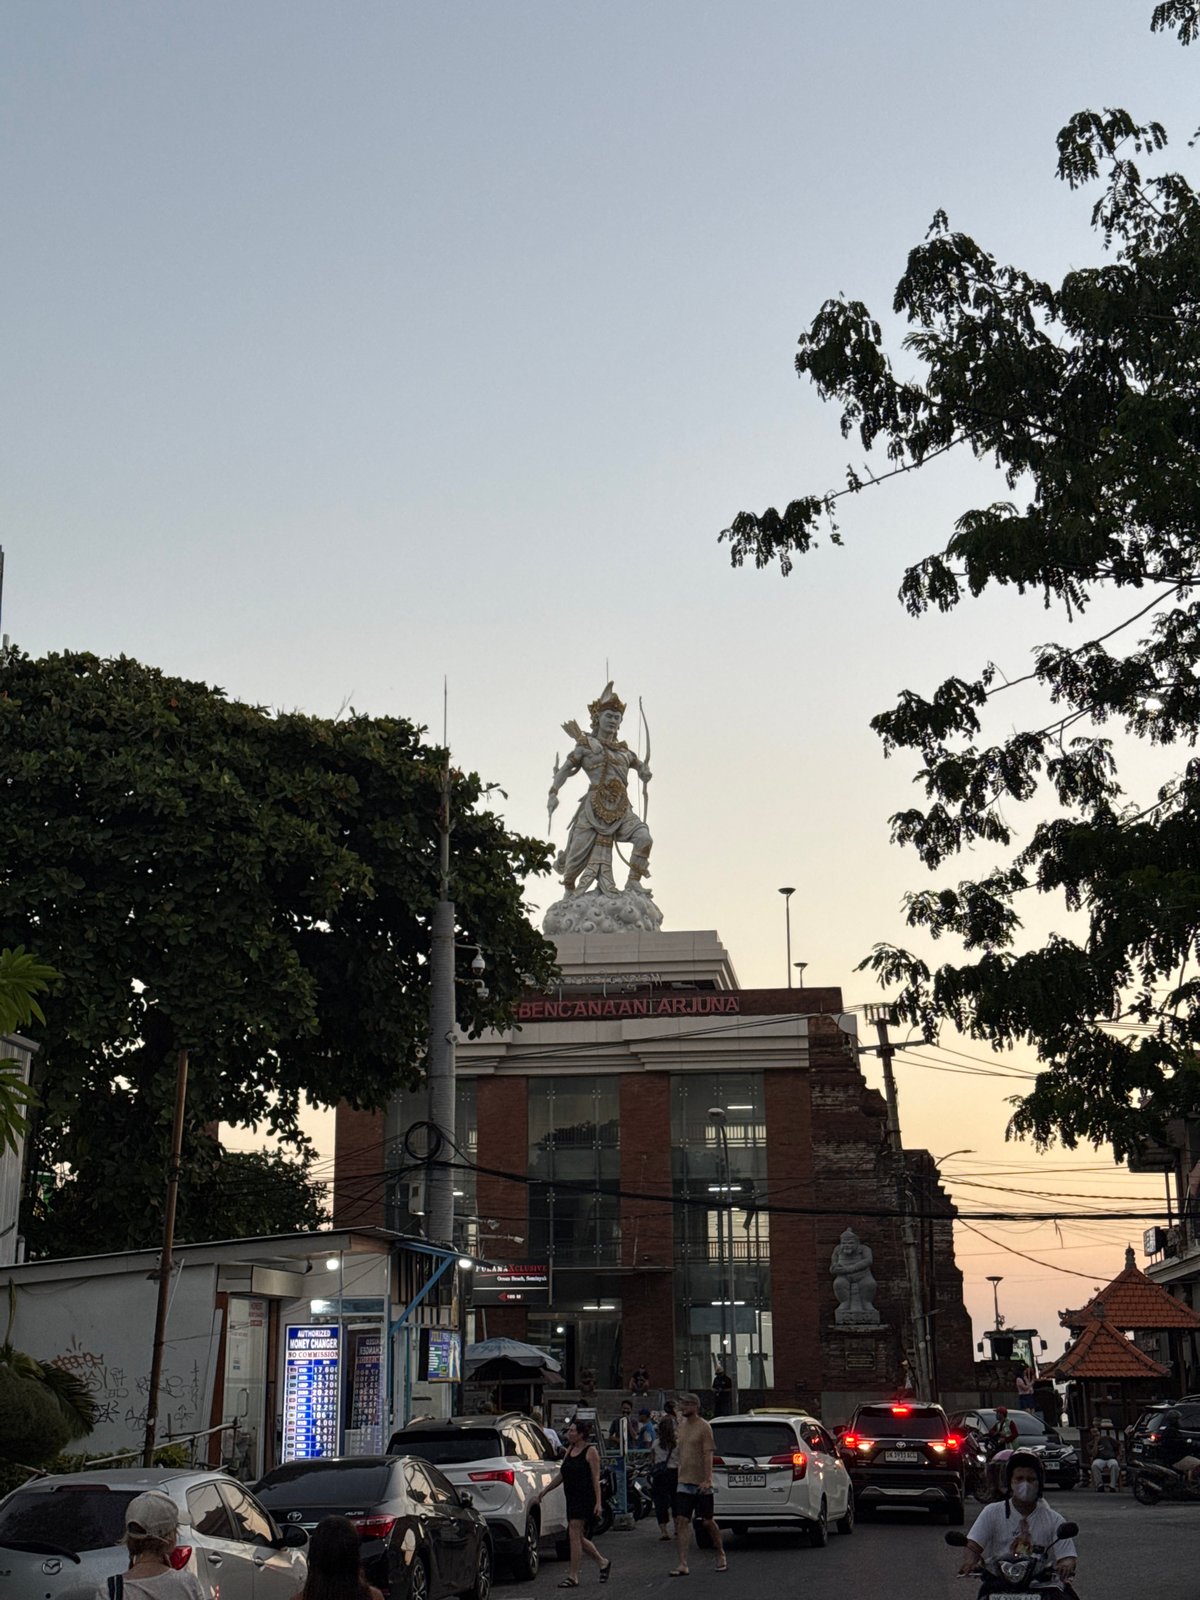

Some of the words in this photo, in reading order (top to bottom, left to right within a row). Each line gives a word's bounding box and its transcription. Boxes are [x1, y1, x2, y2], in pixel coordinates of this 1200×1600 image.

[657, 996, 740, 1014] ARJUNA
[297, 1329, 331, 1338] AUTHORIZED
[290, 1338, 310, 1349] MONEY
[310, 1338, 338, 1349] CHANGER
